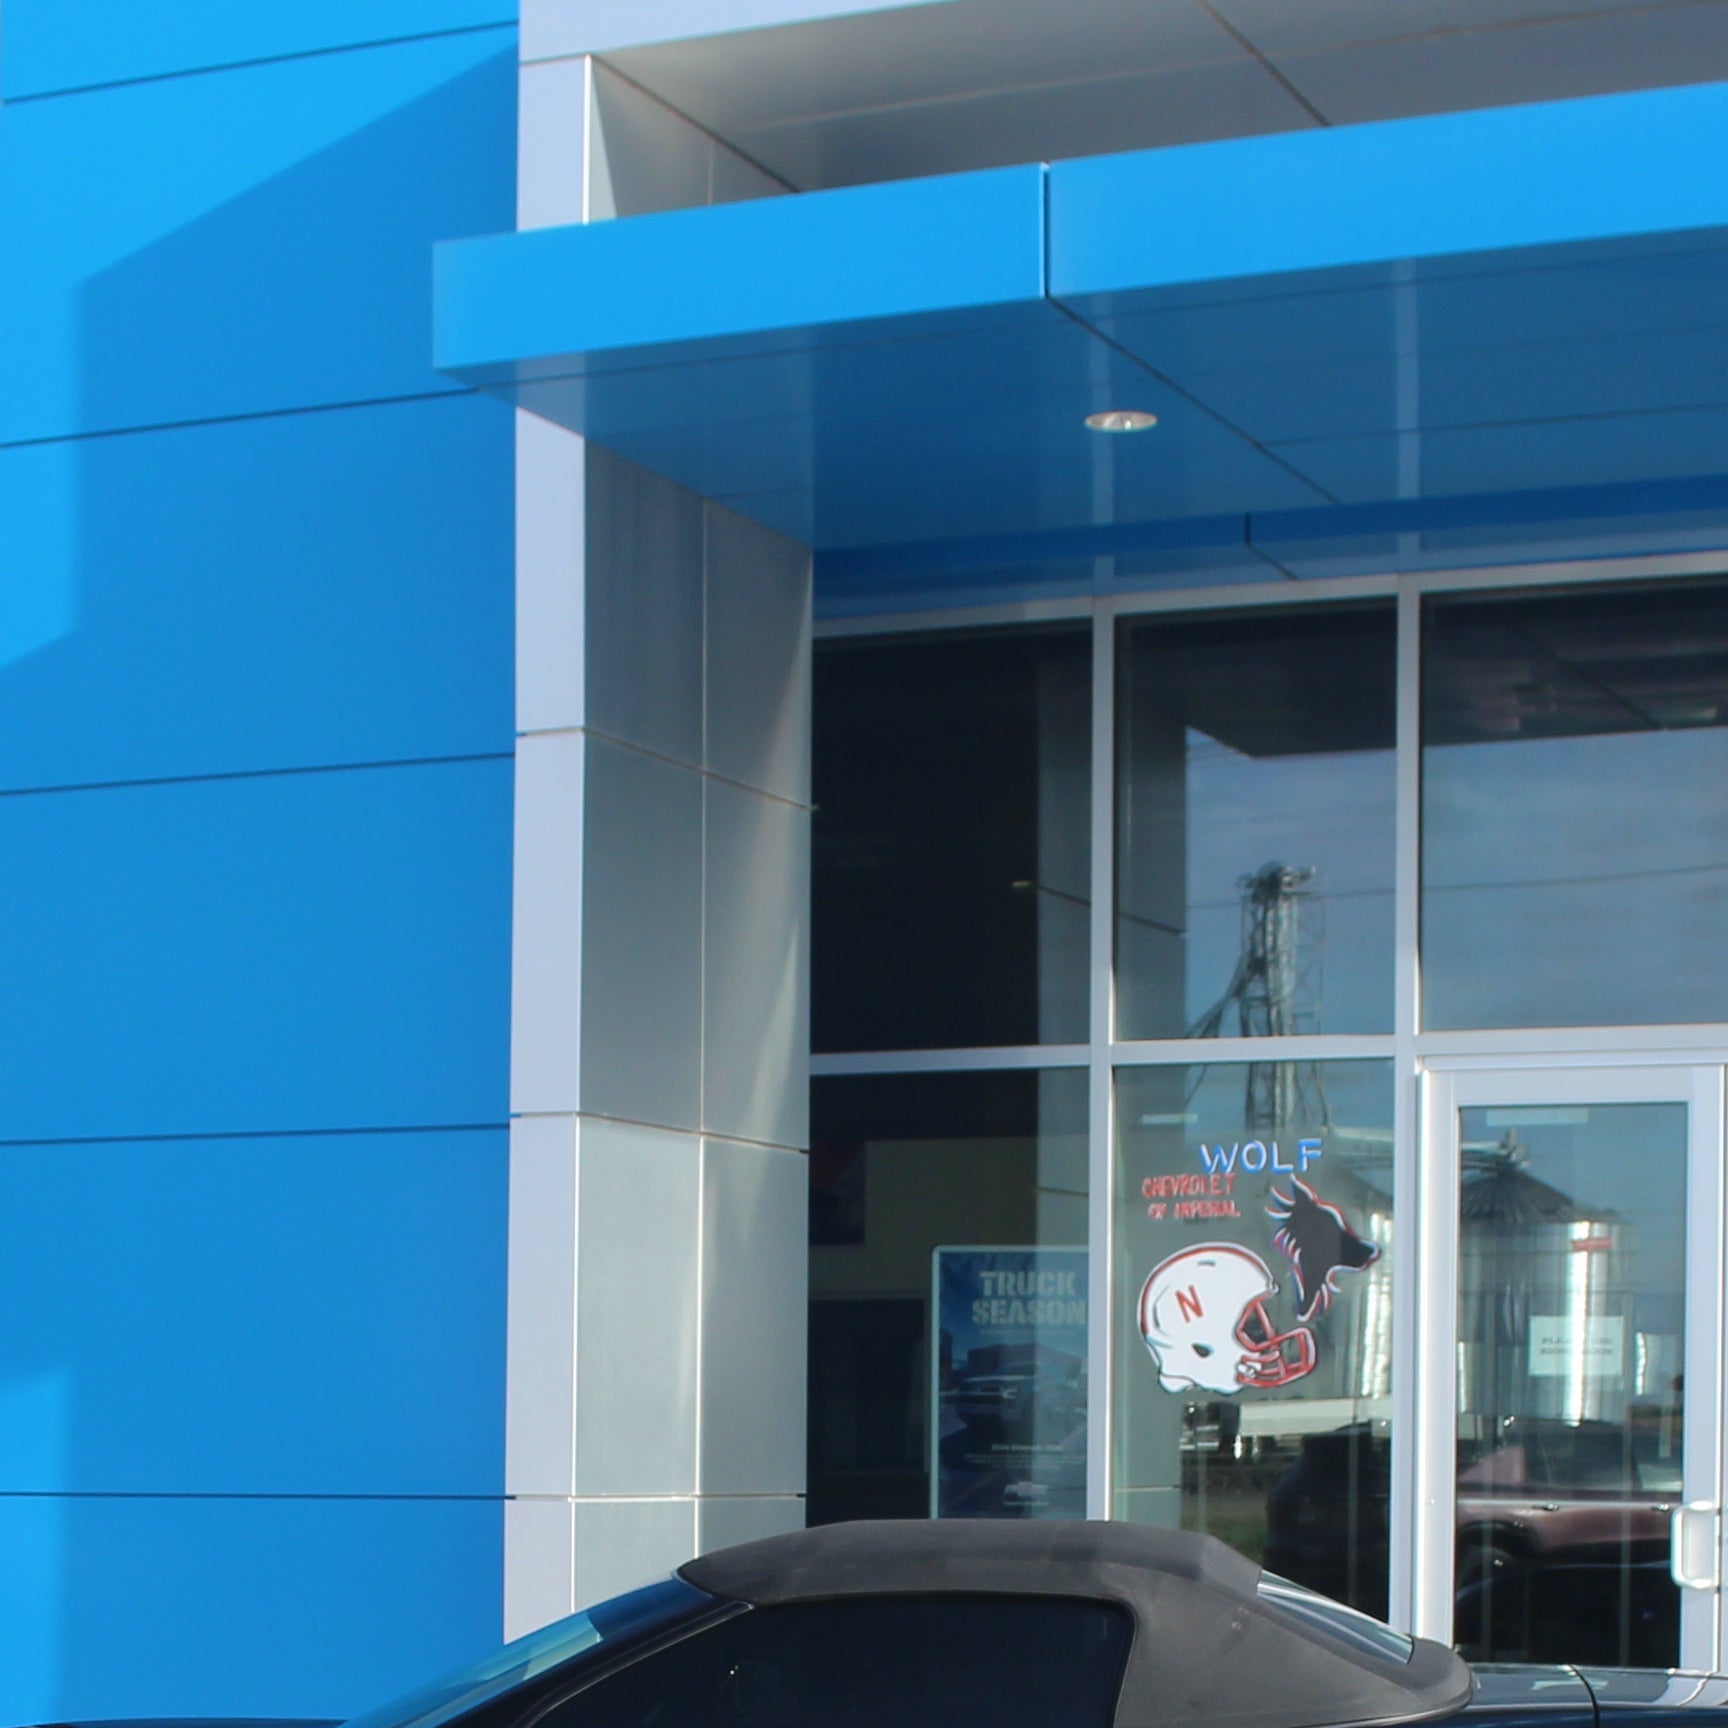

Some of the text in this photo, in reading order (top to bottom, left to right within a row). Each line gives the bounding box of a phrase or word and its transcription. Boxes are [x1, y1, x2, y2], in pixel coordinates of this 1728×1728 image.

[1199, 1138, 1322, 1174] WOLF
[1141, 1173, 1237, 1198] CHEVROLET
[1148, 1200, 1241, 1219] OF IMPERIAL
[979, 1270, 1076, 1296] TRUCK
[972, 1299, 1086, 1324] SEASON
[1175, 1284, 1203, 1323] N
